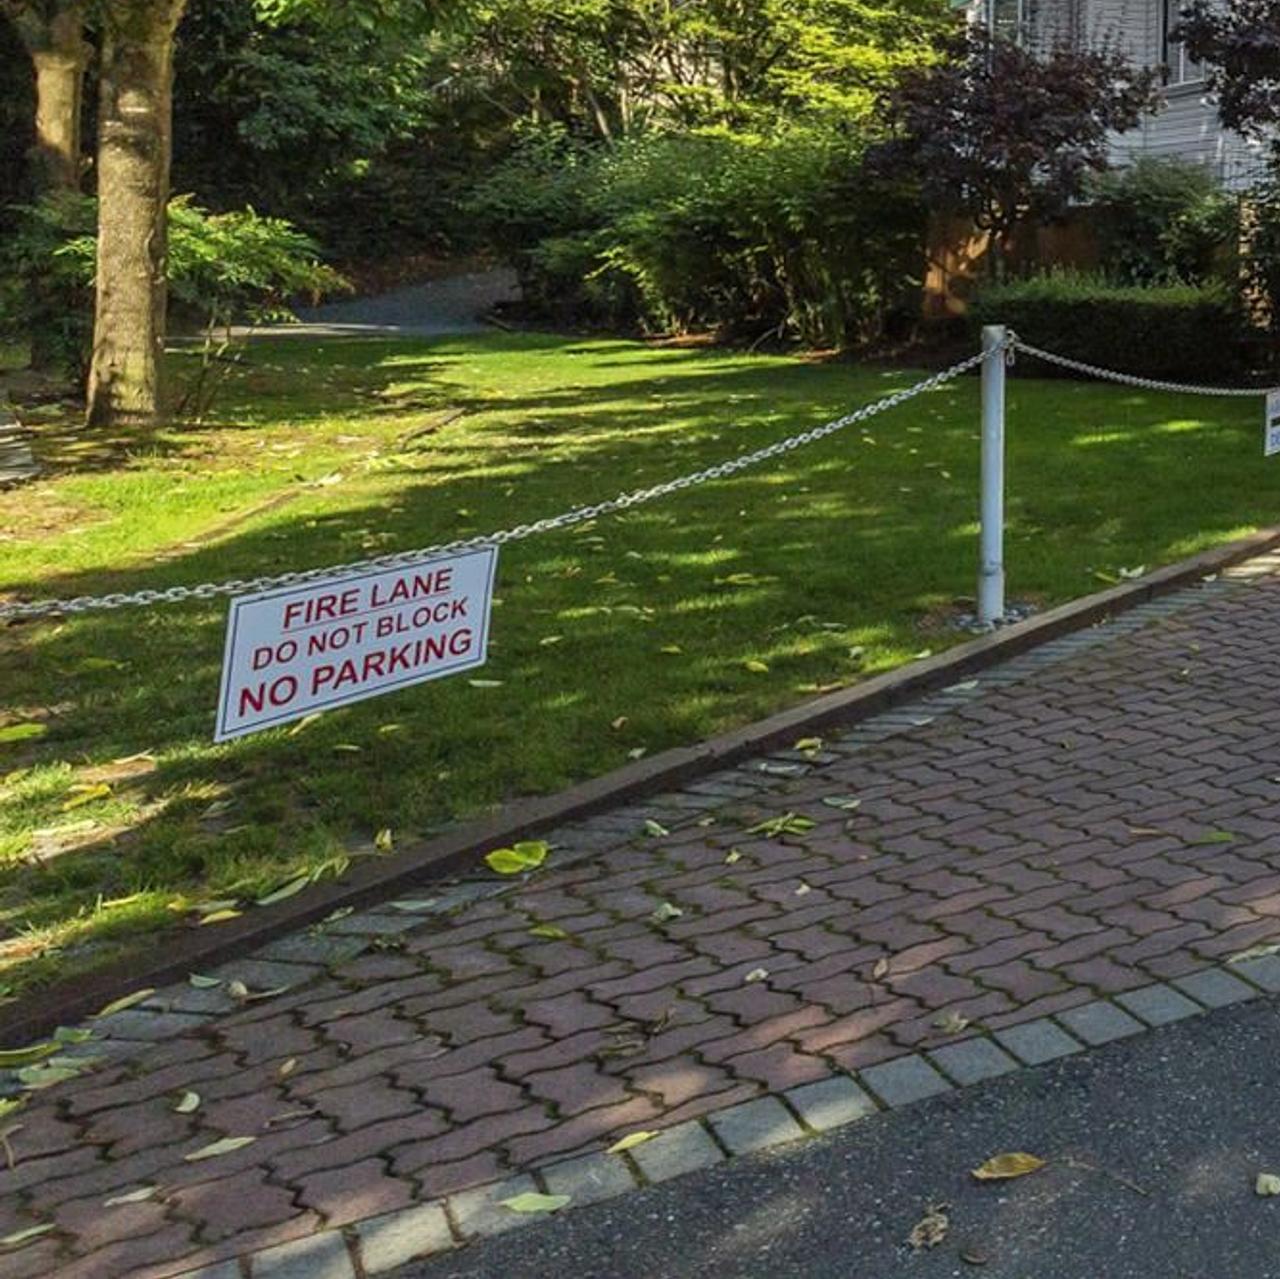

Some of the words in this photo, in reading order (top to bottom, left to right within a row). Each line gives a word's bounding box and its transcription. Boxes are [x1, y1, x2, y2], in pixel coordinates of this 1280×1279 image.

[252, 640, 297, 671] DO
[307, 621, 368, 657] NOT
[375, 596, 469, 639] BLOCK
[283, 588, 360, 629] FIRE
[370, 568, 453, 608] LANE
[238, 675, 298, 718] NO
[311, 627, 472, 696] PARKING
